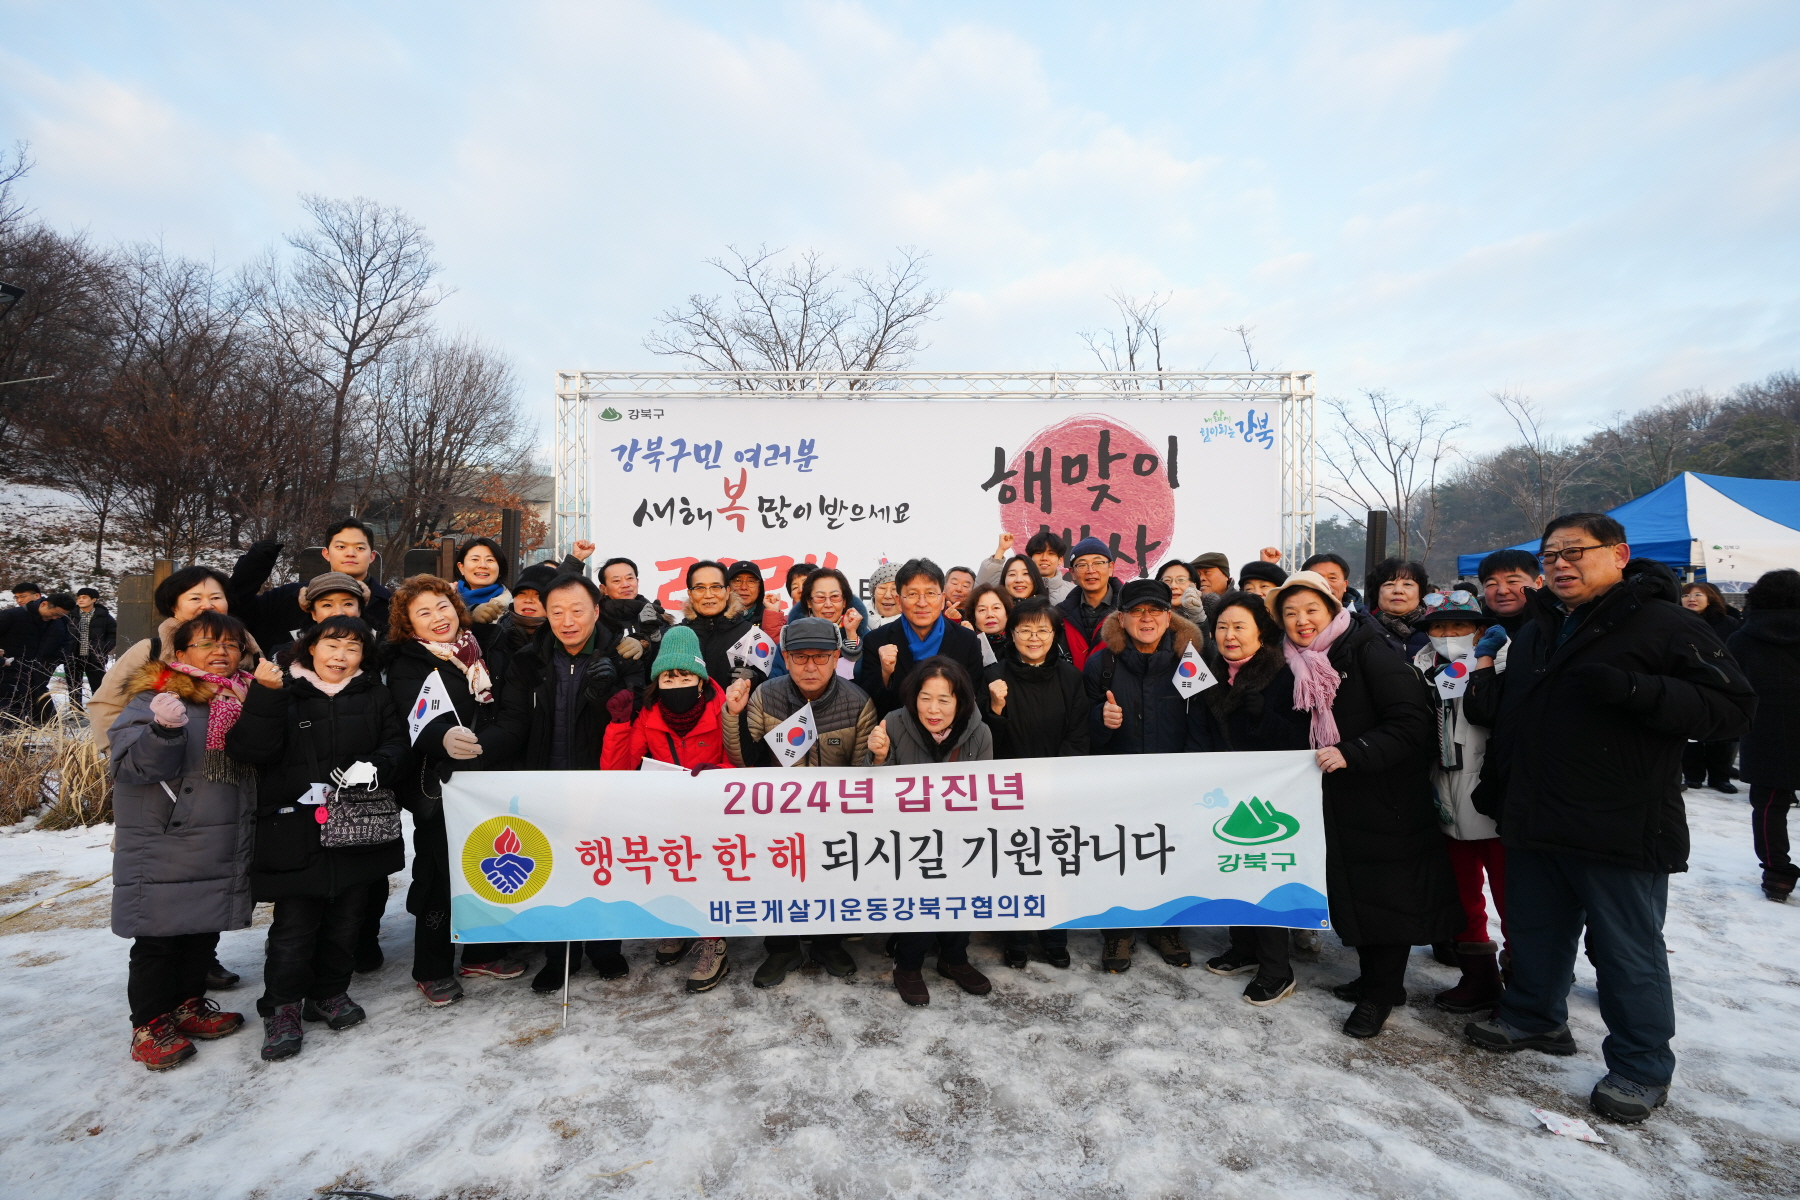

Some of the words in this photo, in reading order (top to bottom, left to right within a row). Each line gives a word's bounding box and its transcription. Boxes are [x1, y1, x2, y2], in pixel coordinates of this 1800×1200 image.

[627, 408, 665, 420] 강북구
[1234, 409, 1275, 450] 강북
[610, 436, 723, 473] 강북구민
[733, 438, 819, 473] 여러분
[981, 429, 1180, 515] 해맞이
[632, 496, 713, 532] 새해
[716, 467, 750, 533] 복
[757, 495, 812, 529] 많이
[818, 494, 911, 530] 받으세요
[723, 777, 875, 815] 2024년
[895, 772, 1025, 813] 갑진년
[575, 833, 702, 887] 행복한
[711, 833, 756, 883] 한
[767, 831, 807, 883] 해
[821, 826, 947, 882] 되시길
[961, 822, 1176, 880] 기원합니다
[1217, 852, 1298, 873] 강북구
[709, 894, 1046, 924] 바르게살기운동강북구협의회
